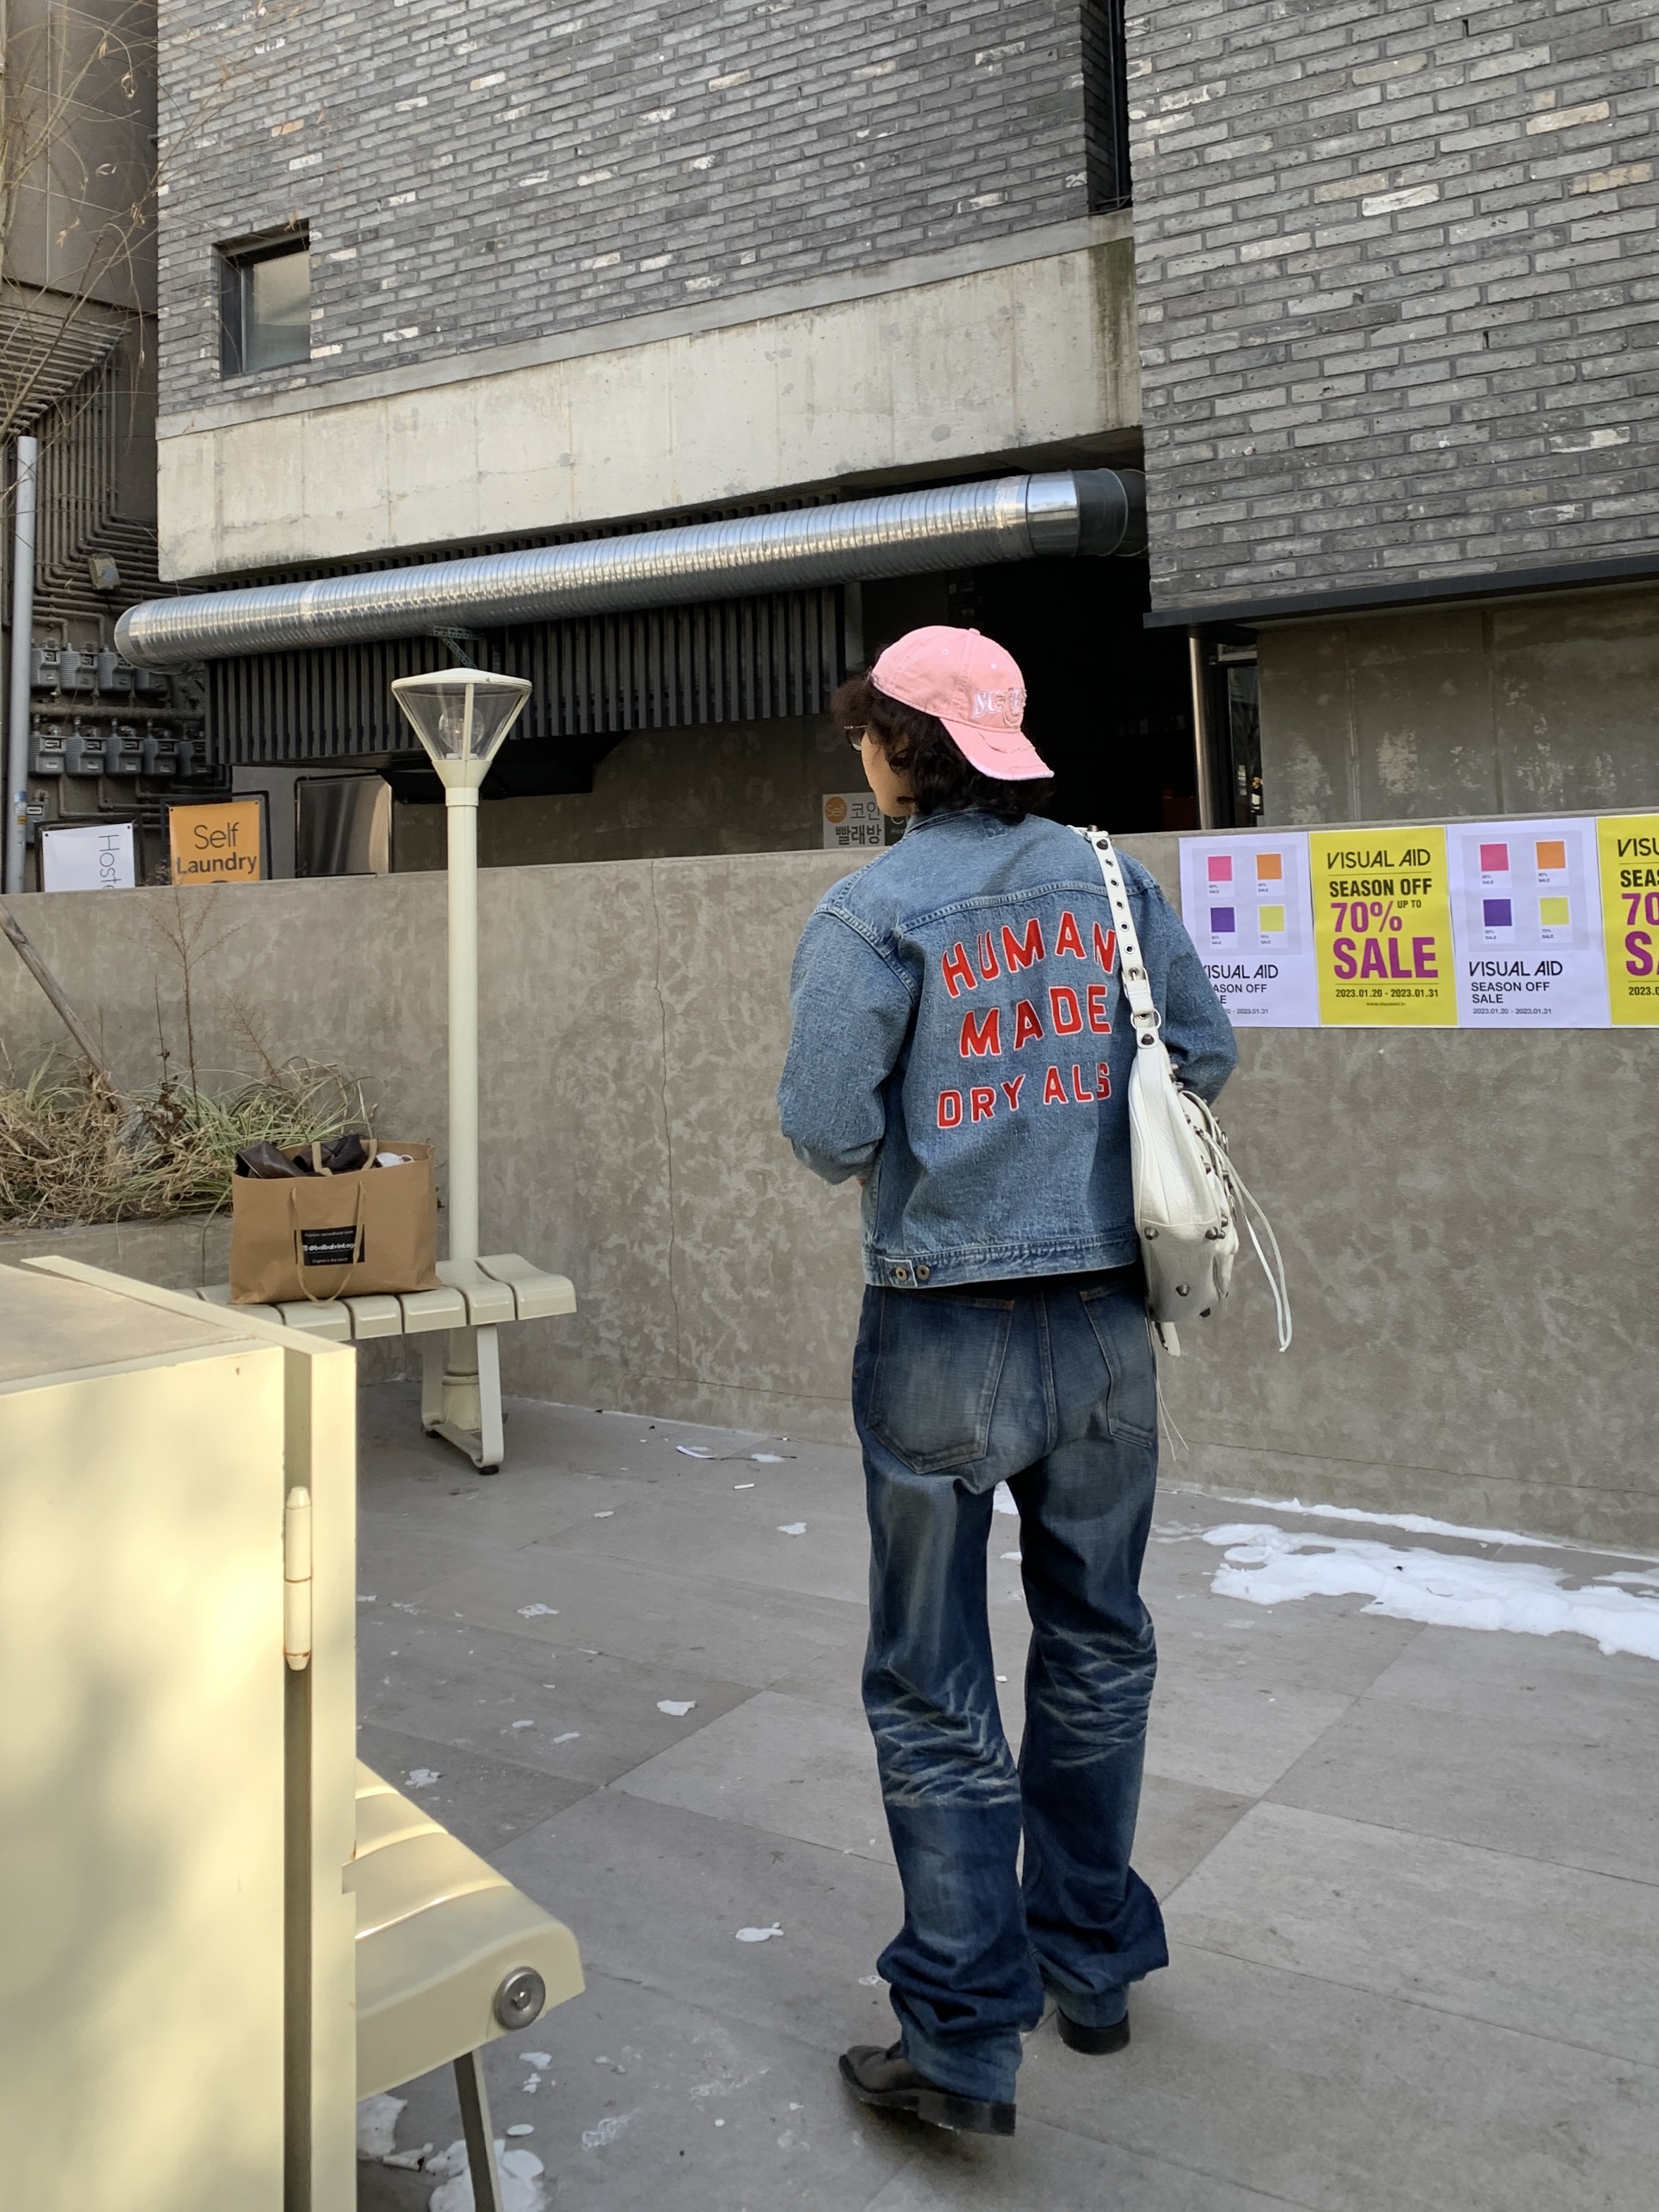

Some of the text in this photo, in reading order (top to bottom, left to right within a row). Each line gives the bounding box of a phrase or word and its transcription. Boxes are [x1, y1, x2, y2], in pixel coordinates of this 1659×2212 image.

[851, 802, 880, 821] 코인
[194, 822, 239, 850] Self
[835, 824, 882, 845] 빨래방
[177, 852, 257, 874] Laundry
[1327, 848, 1431, 869] VISUAL AID
[1329, 878, 1432, 897] SEASON OFF
[1620, 869, 1659, 888] SEA
[1398, 900, 1422, 909] UP TO
[1331, 900, 1403, 933] 70%
[941, 911, 1116, 998] HUMAN
[1333, 936, 1439, 980] SALE
[1204, 964, 1279, 979] ISUAL AID
[1469, 960, 1563, 976] VISUAL AID
[1213, 983, 1267, 993] ASON OFF
[1336, 989, 1383, 998] 2023.01.20
[1391, 988, 1439, 998] 2023.01.31
[1471, 981, 1550, 992] SEASON OFF
[1472, 993, 1503, 1003] SALE
[959, 984, 1112, 1057] MADE
[937, 1074, 1026, 1129] DRY
